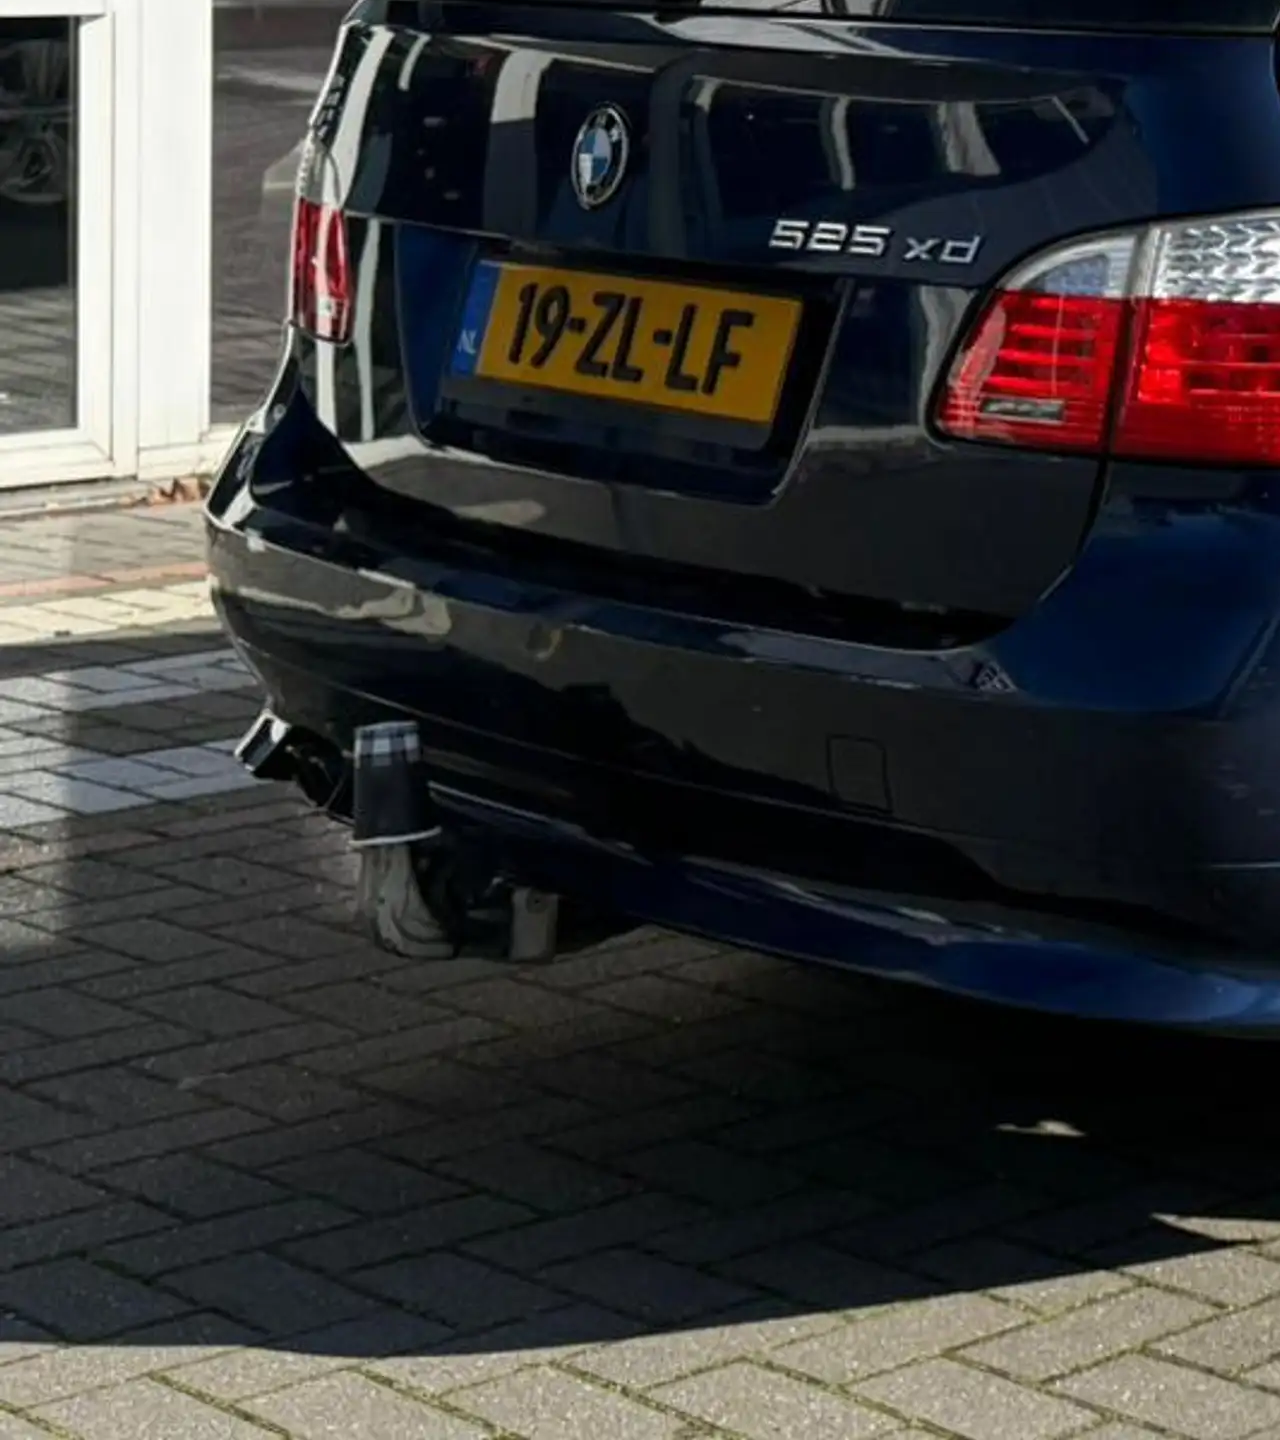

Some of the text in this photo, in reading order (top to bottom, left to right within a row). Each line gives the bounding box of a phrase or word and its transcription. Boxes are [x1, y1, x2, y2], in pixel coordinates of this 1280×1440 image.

[769, 219, 981, 264] 525 xd
[508, 282, 755, 396] 19-ZL-LF
